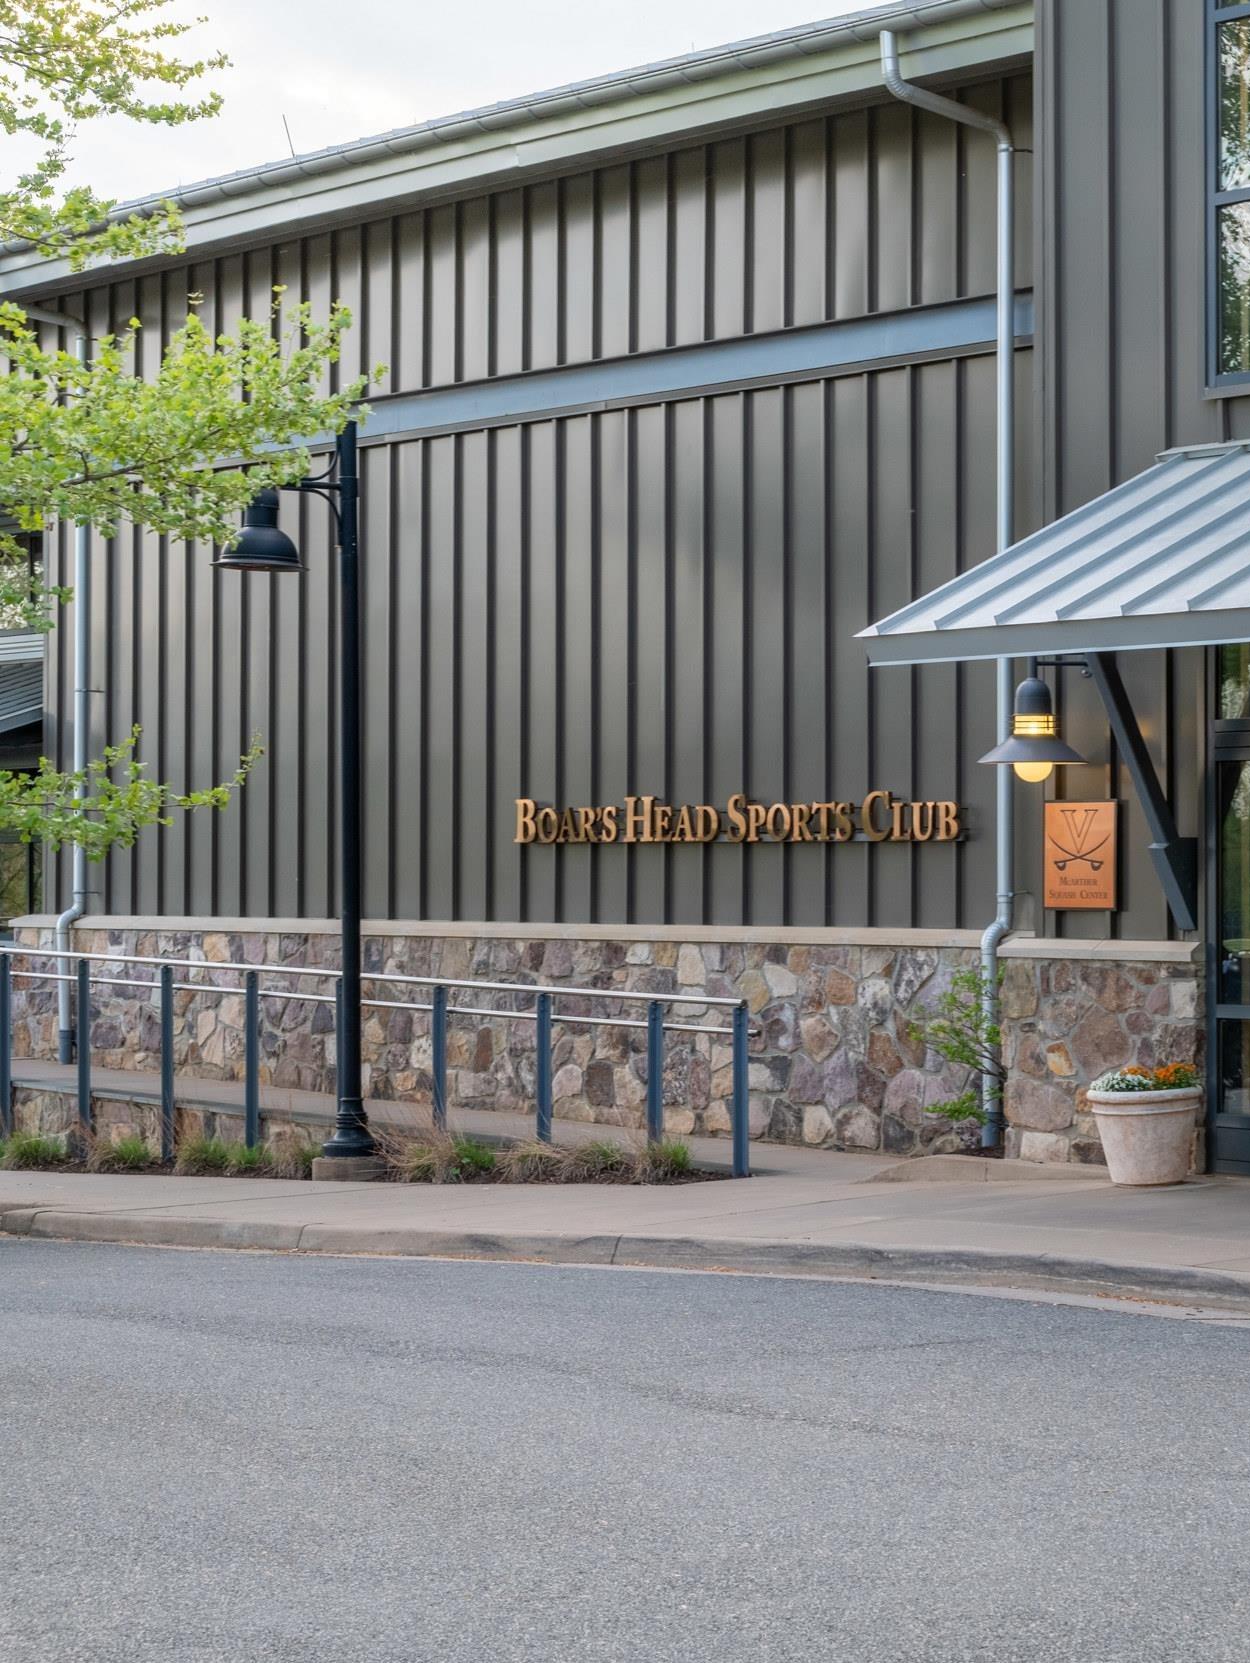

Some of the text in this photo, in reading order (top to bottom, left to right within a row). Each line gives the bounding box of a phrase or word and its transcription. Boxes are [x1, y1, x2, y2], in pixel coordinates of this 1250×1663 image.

[513, 790, 960, 844] BOAR'S HEAD SPORTS CLUB
